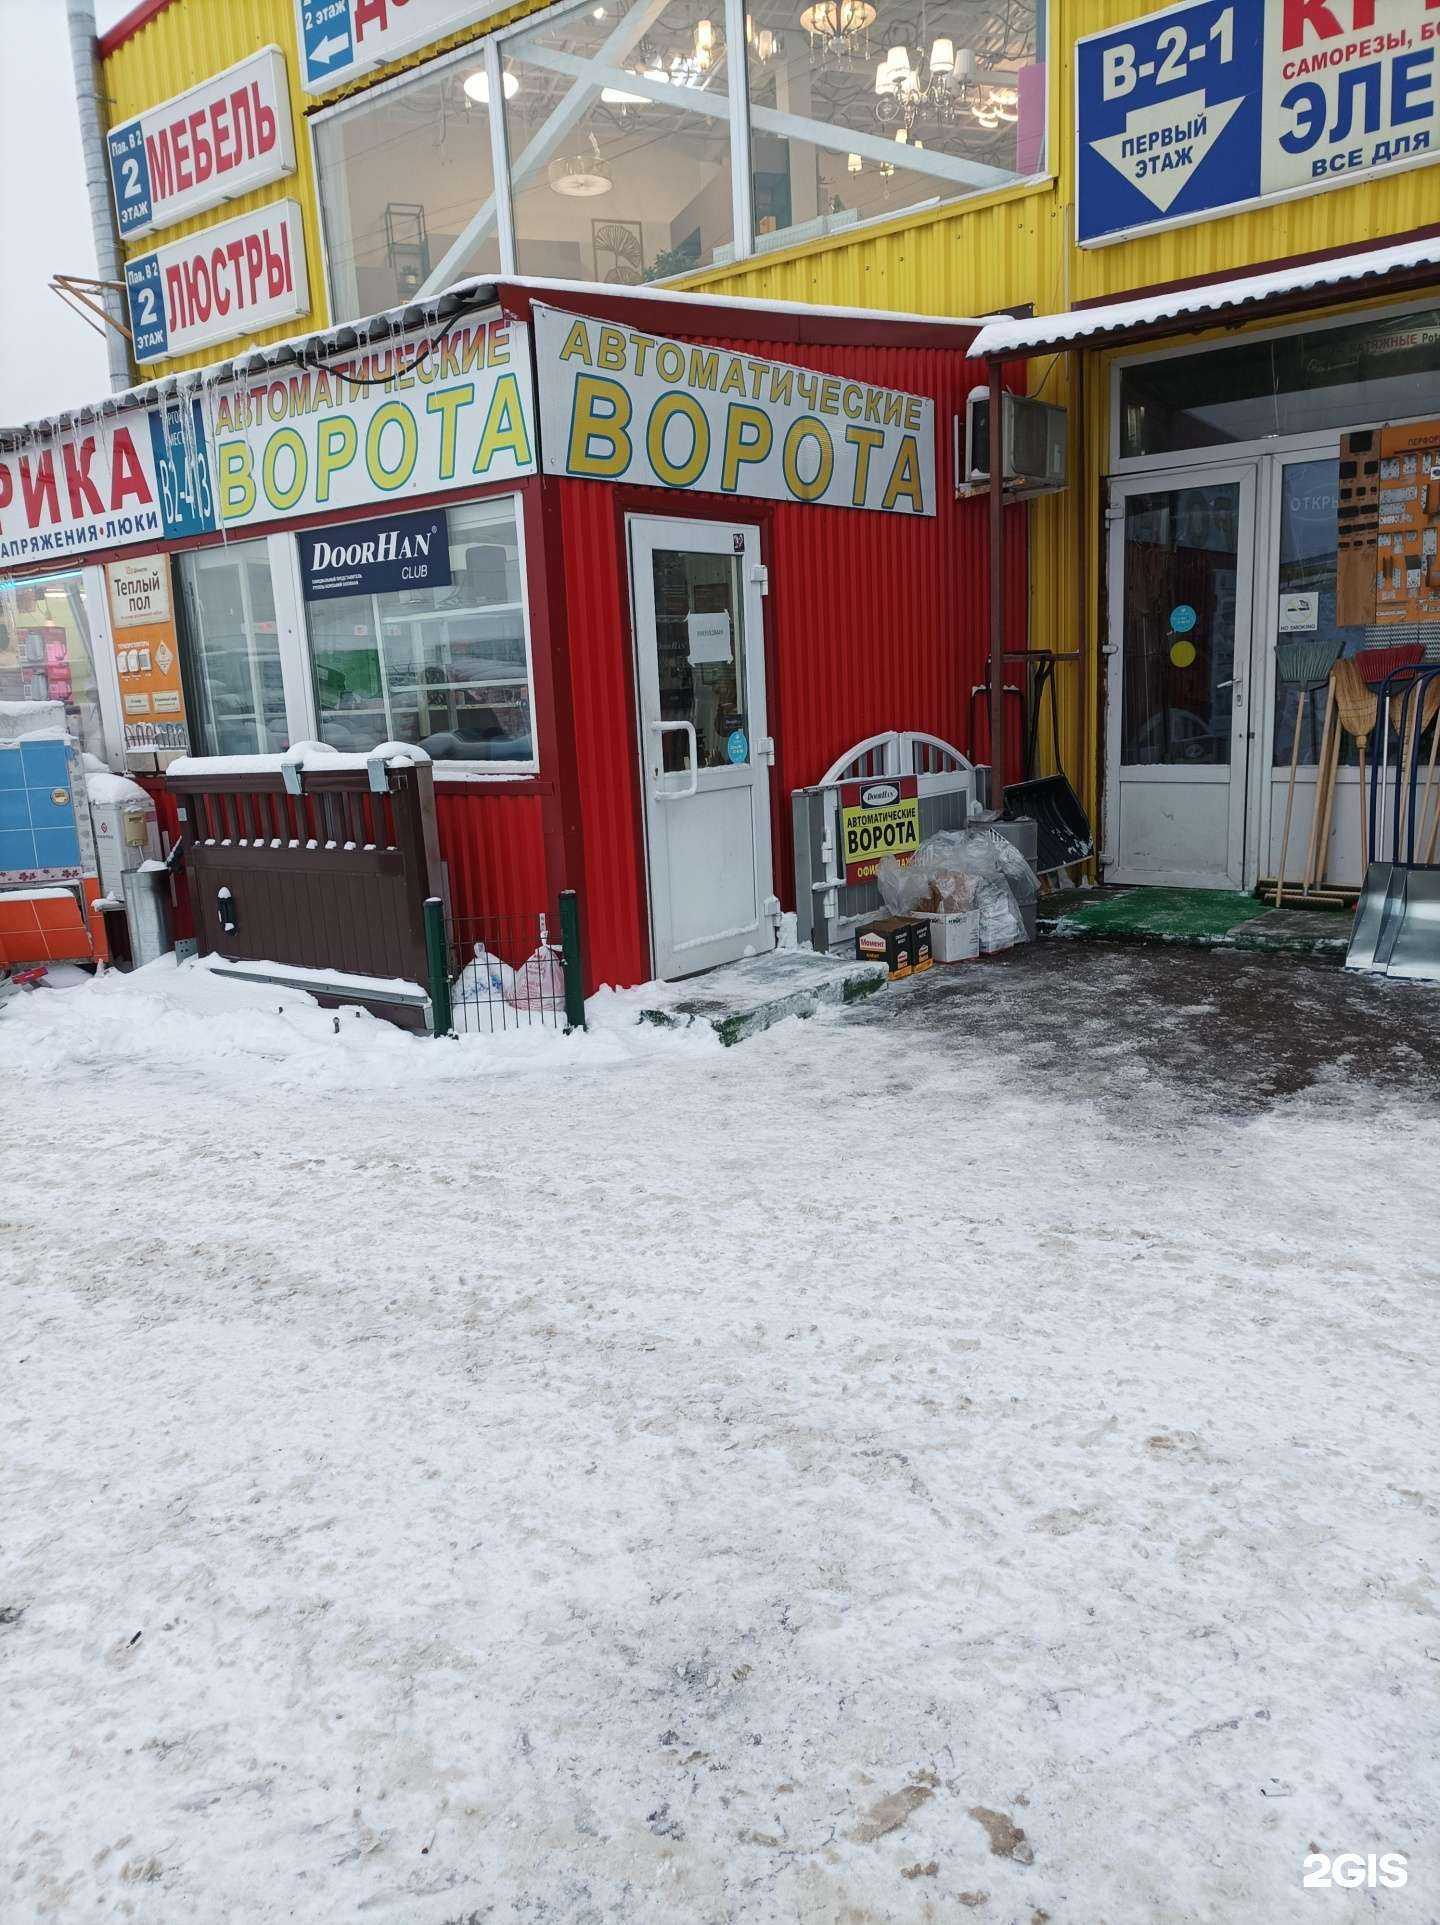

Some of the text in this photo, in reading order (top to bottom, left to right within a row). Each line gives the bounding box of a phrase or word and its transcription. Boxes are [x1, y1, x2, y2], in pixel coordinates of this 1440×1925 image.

[304, 3, 346, 30] 2 этаж
[1103, 7, 1235, 102] В-2-1
[1282, 29, 1413, 80] САМОРЕЗЫ,
[1279, 47, 1435, 155] ЭЛЕ
[145, 80, 276, 204] МЕБЕЛЬ
[1121, 113, 1208, 158] ПЕРВЫЙ
[1312, 130, 1430, 177] ВСЕ ДЛЯ
[121, 158, 143, 199] 2
[1135, 146, 1194, 179] ЭТАЖ
[120, 201, 149, 223] ЭТАЖ
[165, 221, 293, 333] ЛЮСТРЫ
[138, 288, 158, 326] 2
[137, 330, 164, 349] ЭТАЖ
[216, 319, 511, 436] АВТОМАТИЧЕСКИЕ
[558, 320, 922, 431] АВТОМАТИЧЕСКИЕ
[218, 372, 533, 520] ВОРОТА
[565, 372, 924, 513] ВОРОТА
[106, 511, 158, 538] ЛЮКИ
[114, 570, 161, 597] Теплый
[401, 565, 428, 580] CLUB
[129, 596, 151, 612] пол
[847, 808, 916, 828] АВТОМАТИЧЕСКИЕ
[848, 820, 916, 854] ВОРОТА
